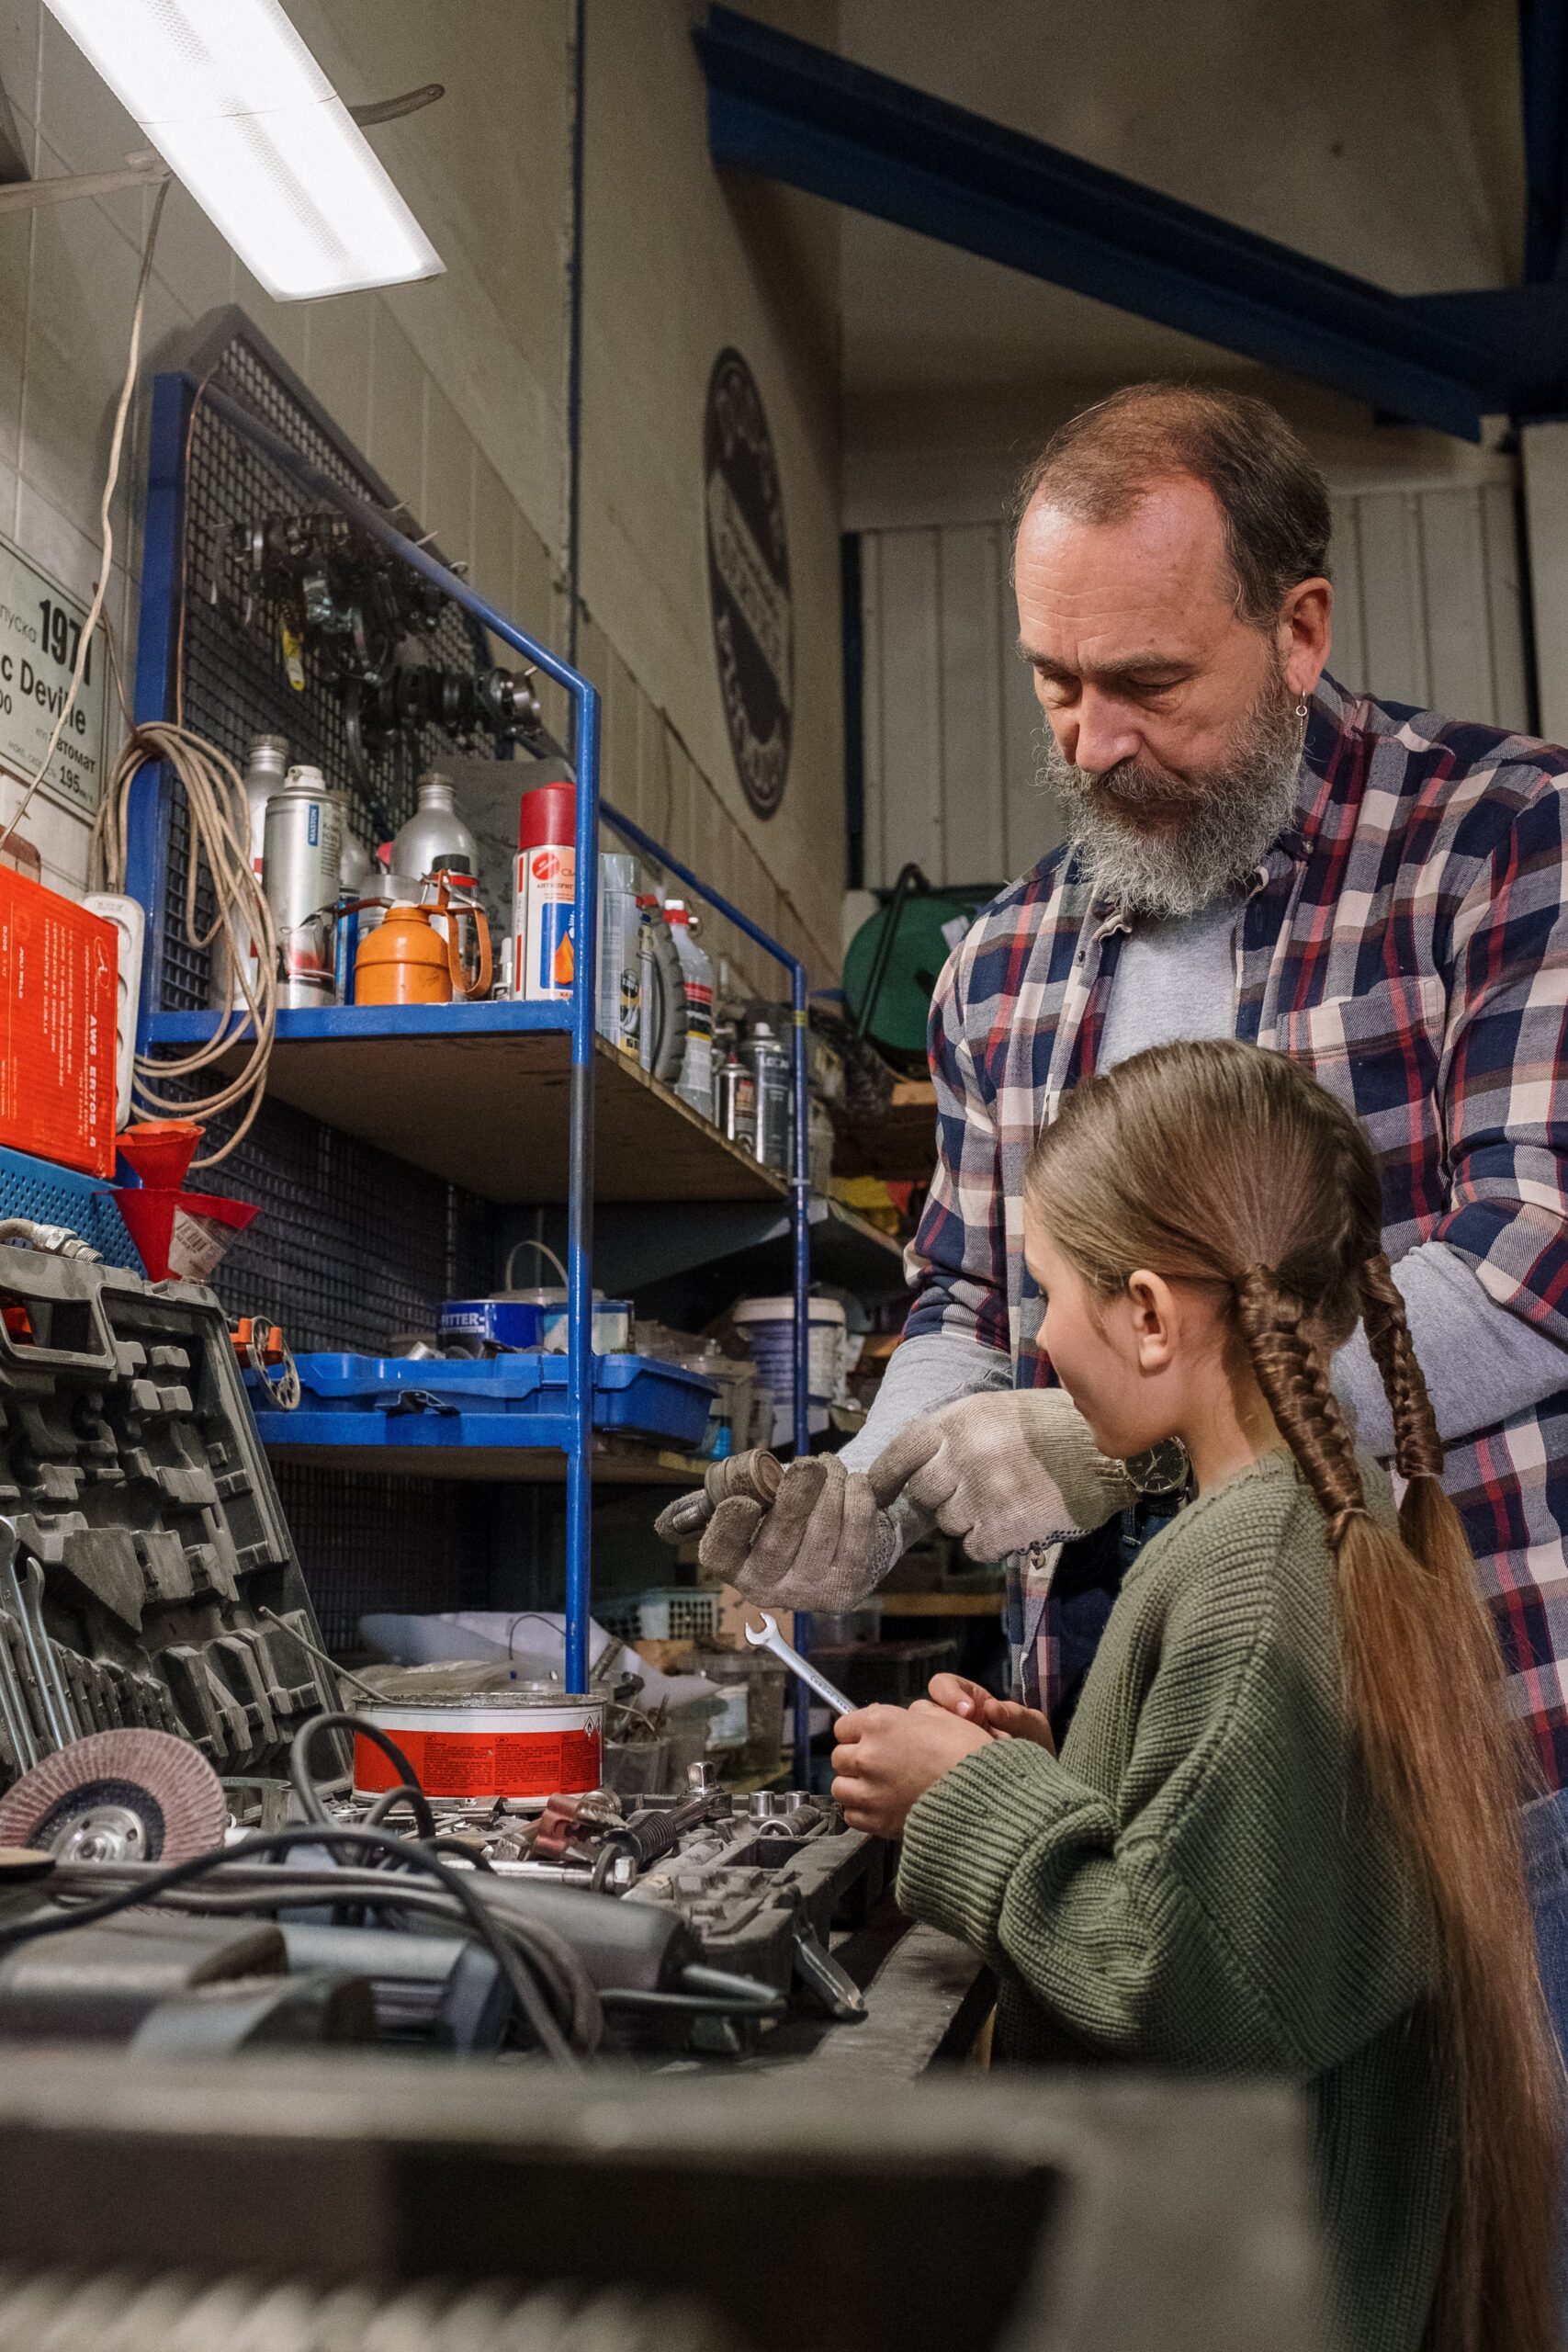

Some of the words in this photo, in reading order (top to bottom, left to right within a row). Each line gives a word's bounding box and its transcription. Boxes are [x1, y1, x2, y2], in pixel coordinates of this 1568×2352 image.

[50, 731, 96, 774] втомат
[60, 765, 80, 794] 195
[309, 808, 317, 842] MASTON
[89, 1014, 97, 1056] AWS
